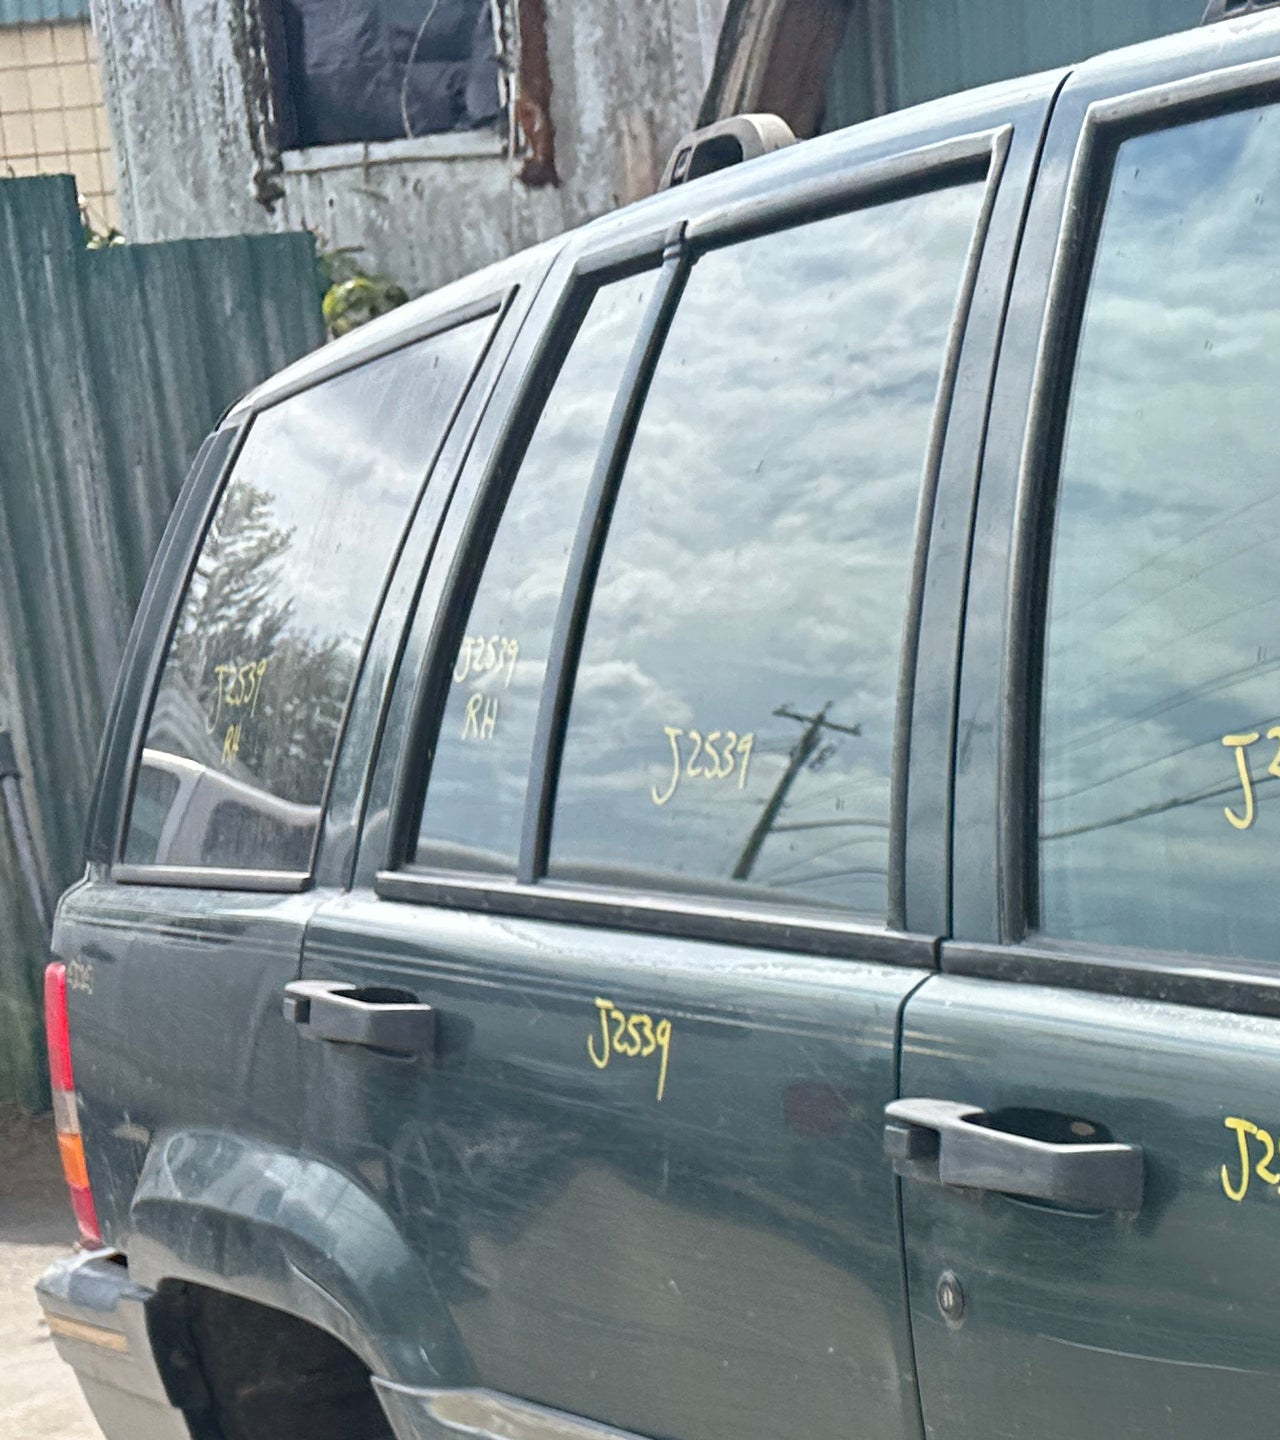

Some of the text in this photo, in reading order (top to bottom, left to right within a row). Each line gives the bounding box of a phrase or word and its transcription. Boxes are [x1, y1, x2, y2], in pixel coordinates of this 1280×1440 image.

[206, 658, 268, 735] J2539
[453, 634, 519, 689] J2539
[460, 693, 499, 741] RH
[652, 725, 754, 805] J2539
[587, 997, 672, 1101] J2539
